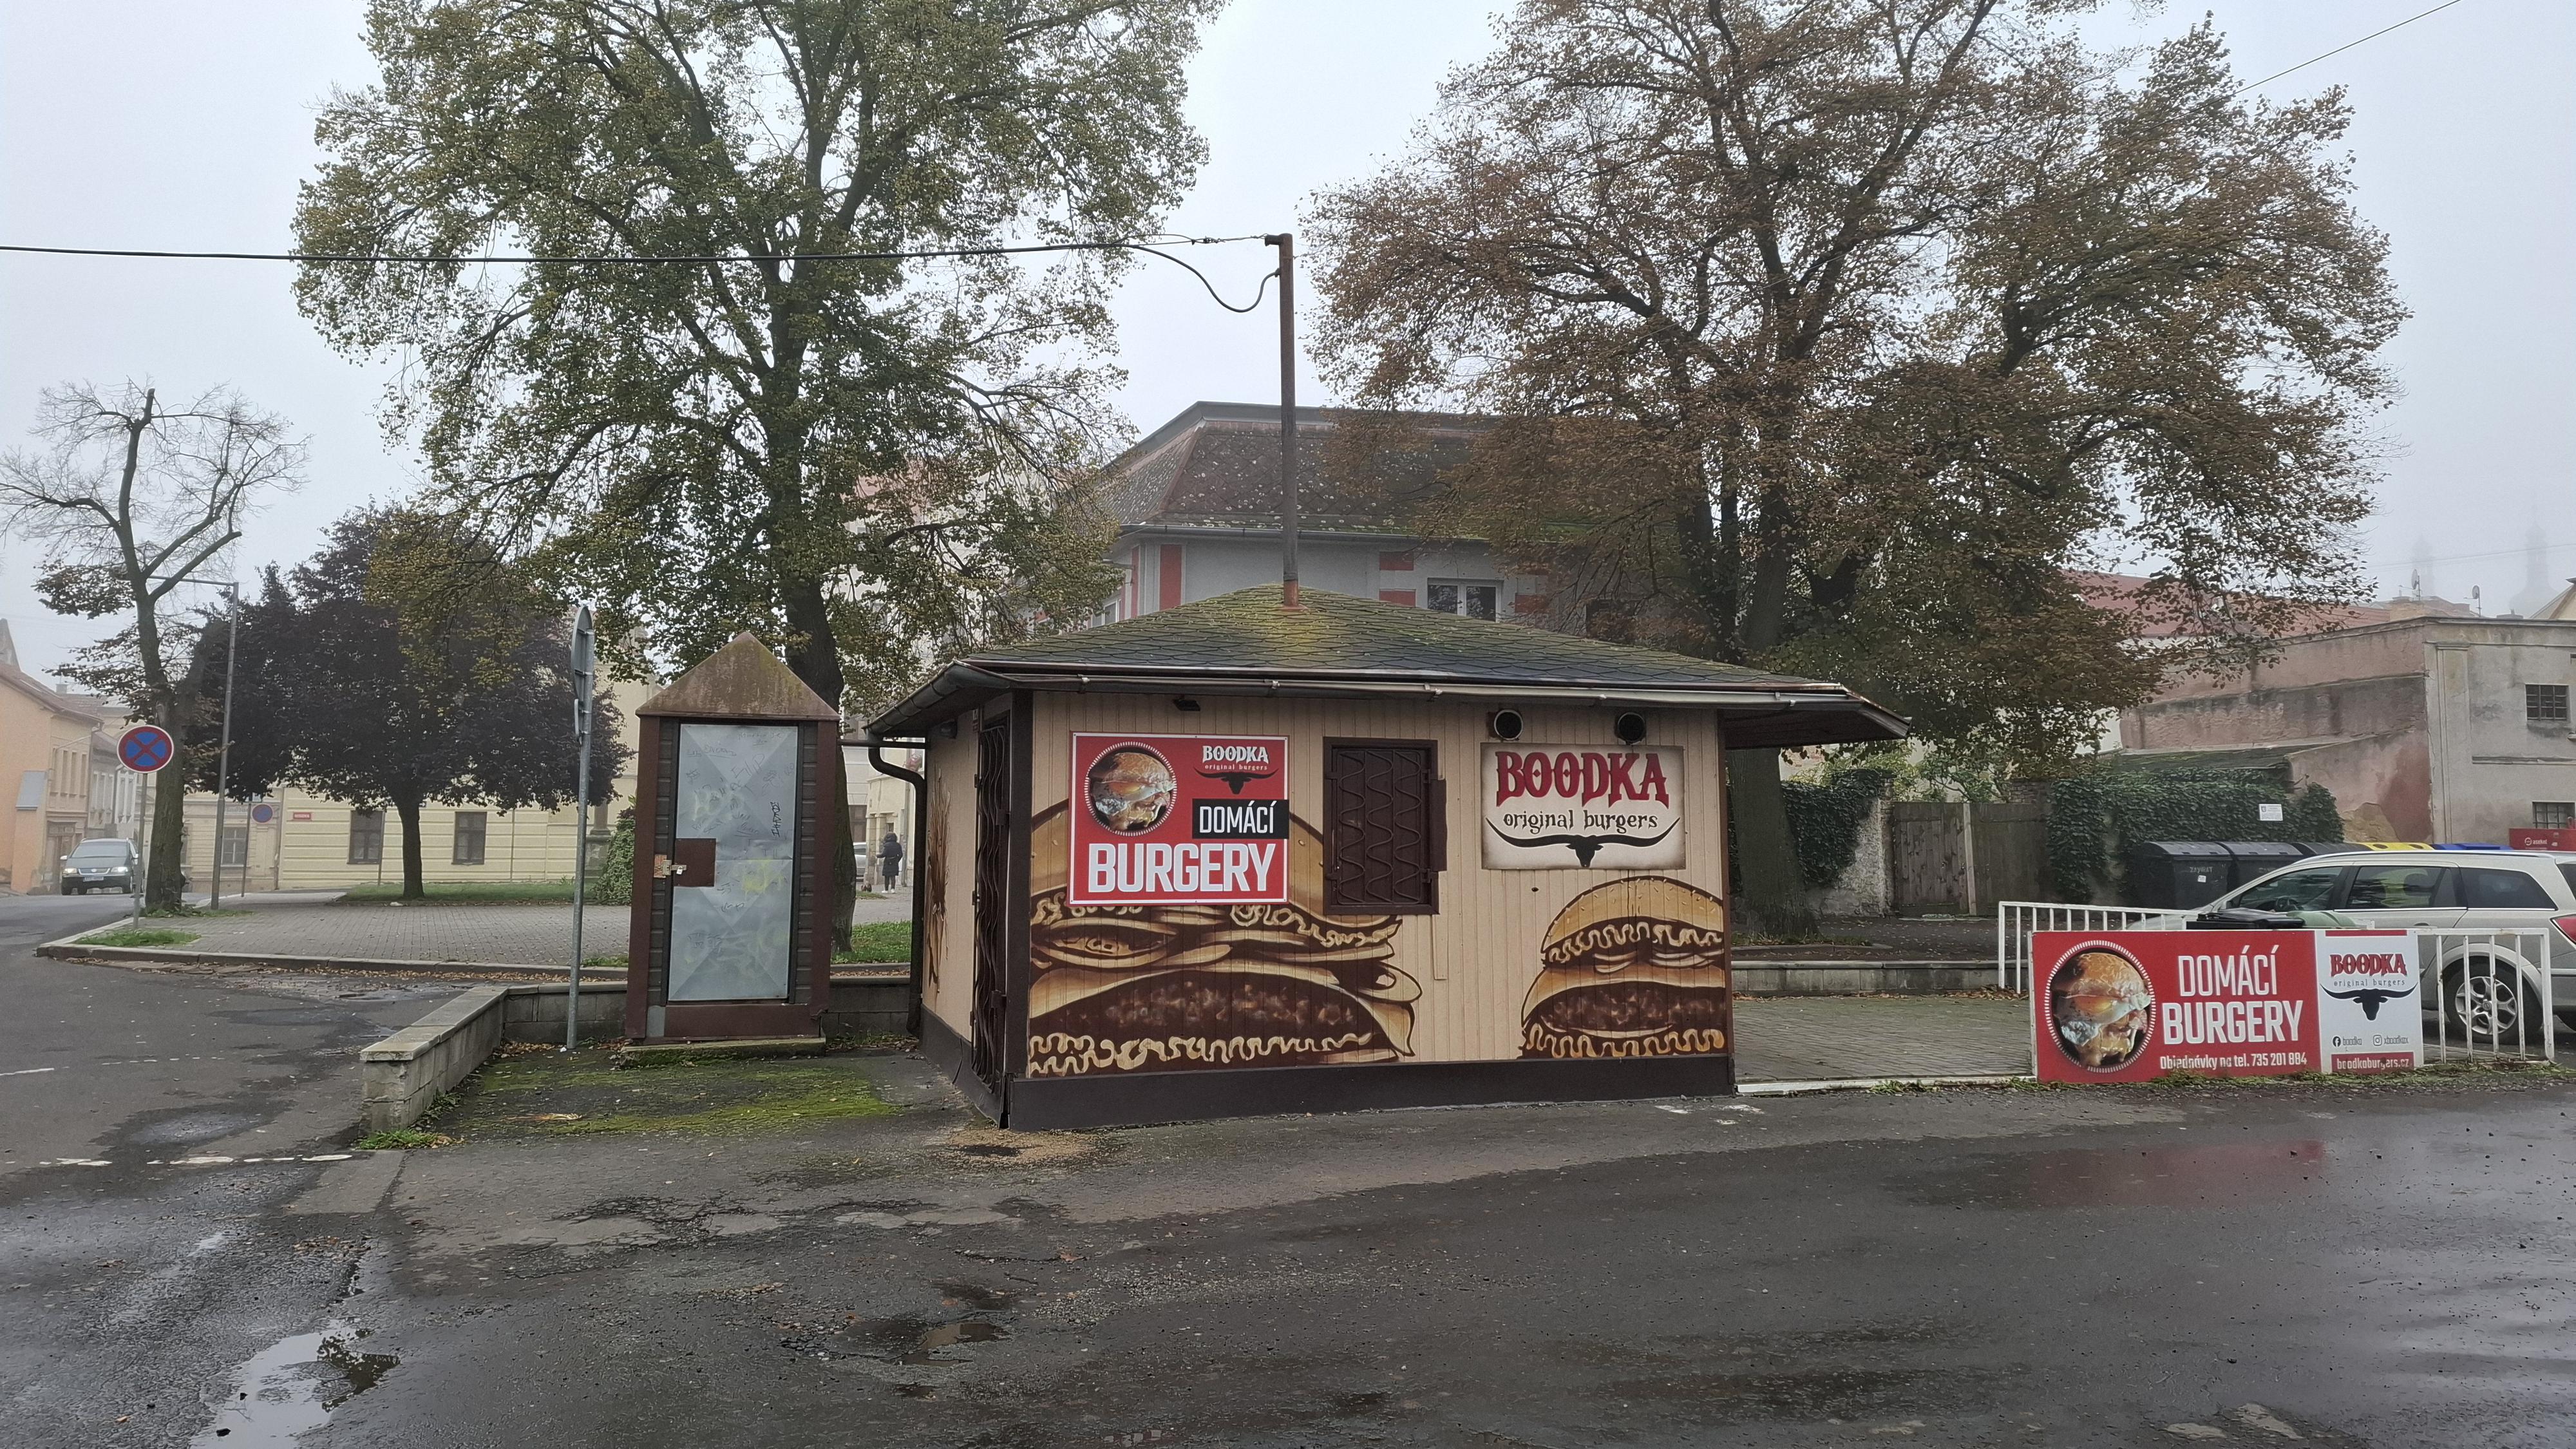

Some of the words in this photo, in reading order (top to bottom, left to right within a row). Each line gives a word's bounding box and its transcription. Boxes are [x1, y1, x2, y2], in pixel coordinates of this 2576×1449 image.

[1202, 745, 1269, 764] BOODKA
[1495, 751, 1669, 810] BOODKA
[1199, 800, 1278, 834] DOMÁCÍ
[1503, 810, 1573, 834] original
[1584, 810, 1658, 834] burgers
[1088, 843, 1276, 893] BURGERY
[2177, 945, 2280, 997] DOMÁCÍ
[2329, 953, 2408, 977] BOODKA
[2334, 979, 2368, 988] original
[2373, 978, 2405, 987] burgers
[2161, 1000, 2304, 1045] BURGERY
[2160, 1054, 2217, 1070] Objednávky
[2220, 1057, 2231, 1067] na
[2234, 1053, 2249, 1067] tel.
[2251, 1054, 2268, 1066] 735
[2271, 1053, 2286, 1066] 201
[2289, 1052, 2307, 1065] 884
